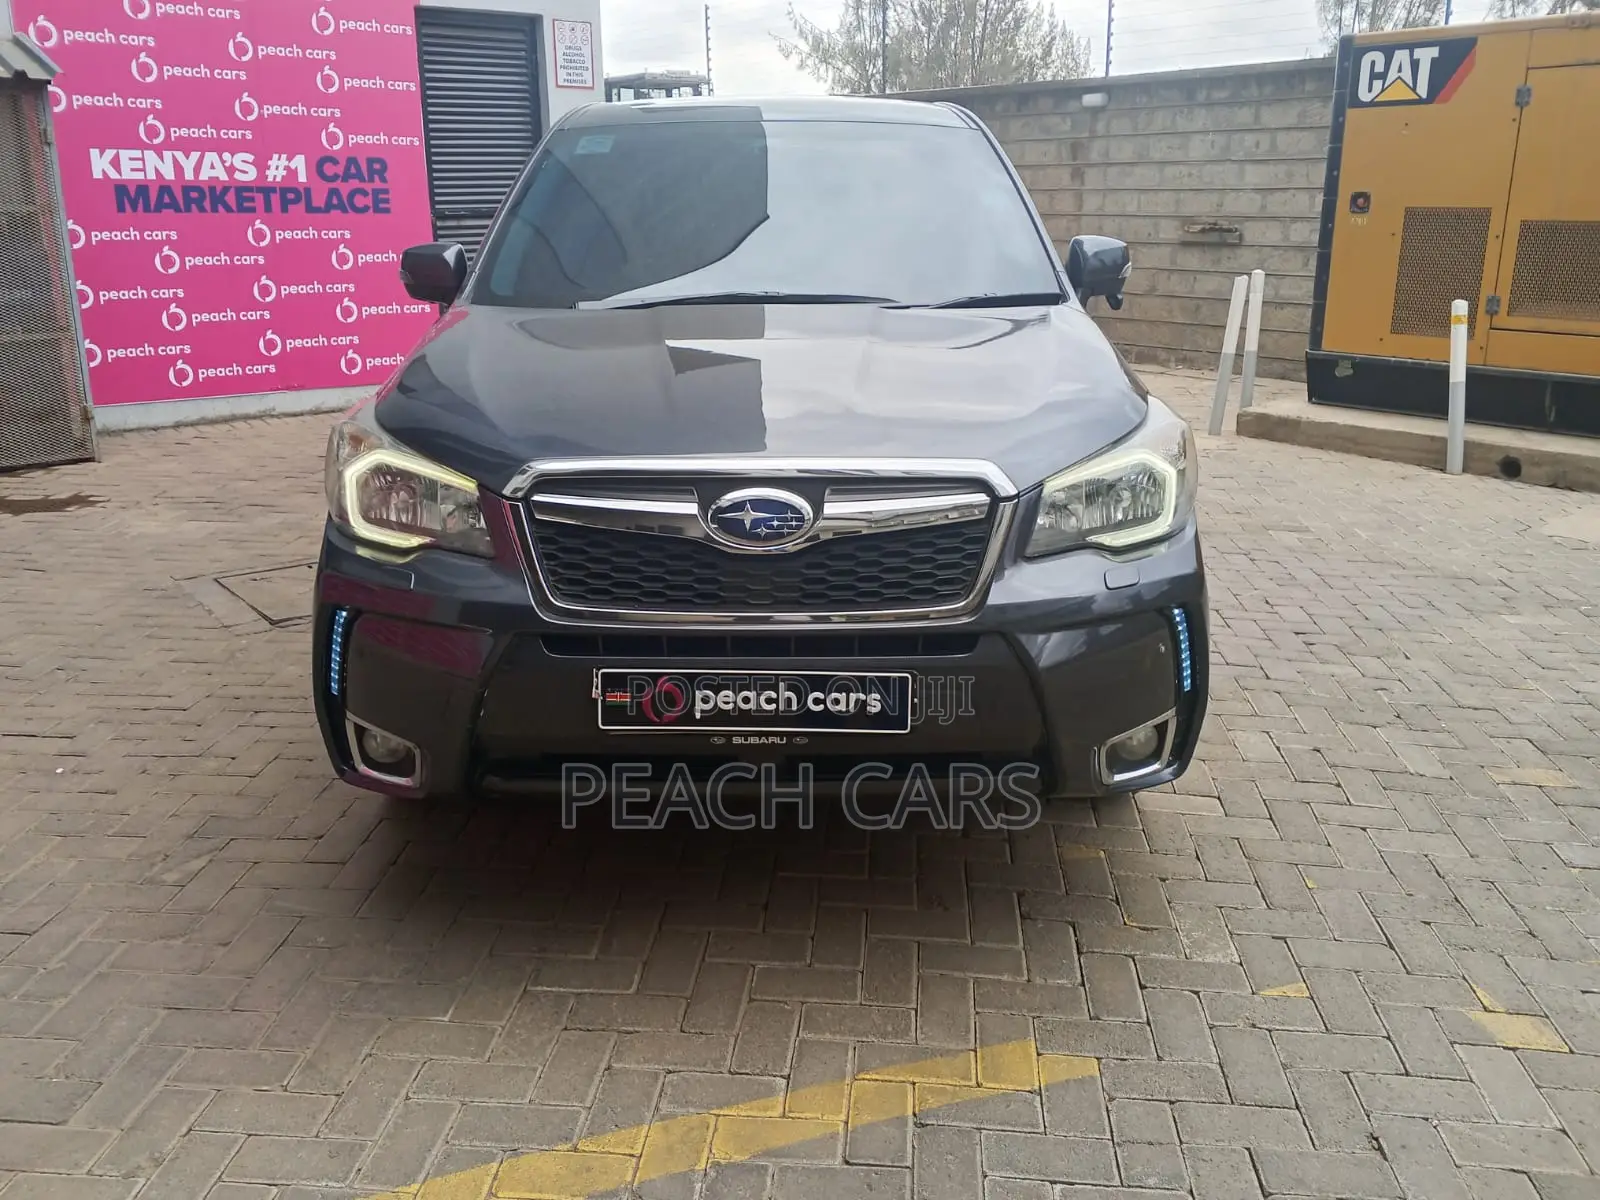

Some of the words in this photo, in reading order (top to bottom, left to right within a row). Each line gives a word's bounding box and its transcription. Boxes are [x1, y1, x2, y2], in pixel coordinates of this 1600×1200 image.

[156, 1, 203, 17] peach
[208, 7, 241, 20] cars
[340, 19, 379, 33] peach
[384, 23, 413, 35] cars
[64, 28, 116, 45] peach
[120, 34, 155, 47] cars
[258, 43, 303, 59] peach
[306, 49, 337, 61] cars
[164, 63, 211, 80] peach
[214, 69, 247, 81] cars
[1358, 46, 1439, 103] CAT
[344, 75, 383, 91] peach
[386, 80, 417, 92] cars
[73, 92, 124, 110] peach
[128, 97, 162, 109] cars
[264, 102, 308, 118] peach
[312, 107, 341, 118] cars
[171, 124, 217, 141] peach
[220, 129, 253, 140] cars
[349, 131, 389, 147] peach
[392, 136, 420, 146] cars
[89, 148, 258, 182] KENYA’S
[265, 153, 307, 183] #1
[315, 155, 389, 183] CAR
[114, 184, 392, 214] MARKETPLACE
[92, 226, 140, 244] peach
[144, 230, 178, 241] cars
[276, 226, 318, 242] peach
[322, 230, 351, 239] cars
[185, 252, 231, 270] peach
[234, 255, 265, 265] cars
[358, 250, 397, 266] peach
[100, 285, 148, 304] peach
[151, 288, 185, 299] cars
[281, 280, 323, 297] peach
[326, 283, 355, 293] cars
[192, 308, 237, 325] peach
[240, 310, 271, 321] cars
[362, 302, 401, 319] peach
[404, 304, 431, 314] cars
[287, 334, 328, 350] peach
[331, 335, 360, 346] cars
[106, 343, 153, 361] peach
[157, 345, 191, 356] cars
[199, 363, 243, 382] peach
[246, 364, 276, 375] cars
[695, 681, 798, 719] peach
[807, 690, 882, 714] cars
[732, 736, 787, 745] SUBARU
